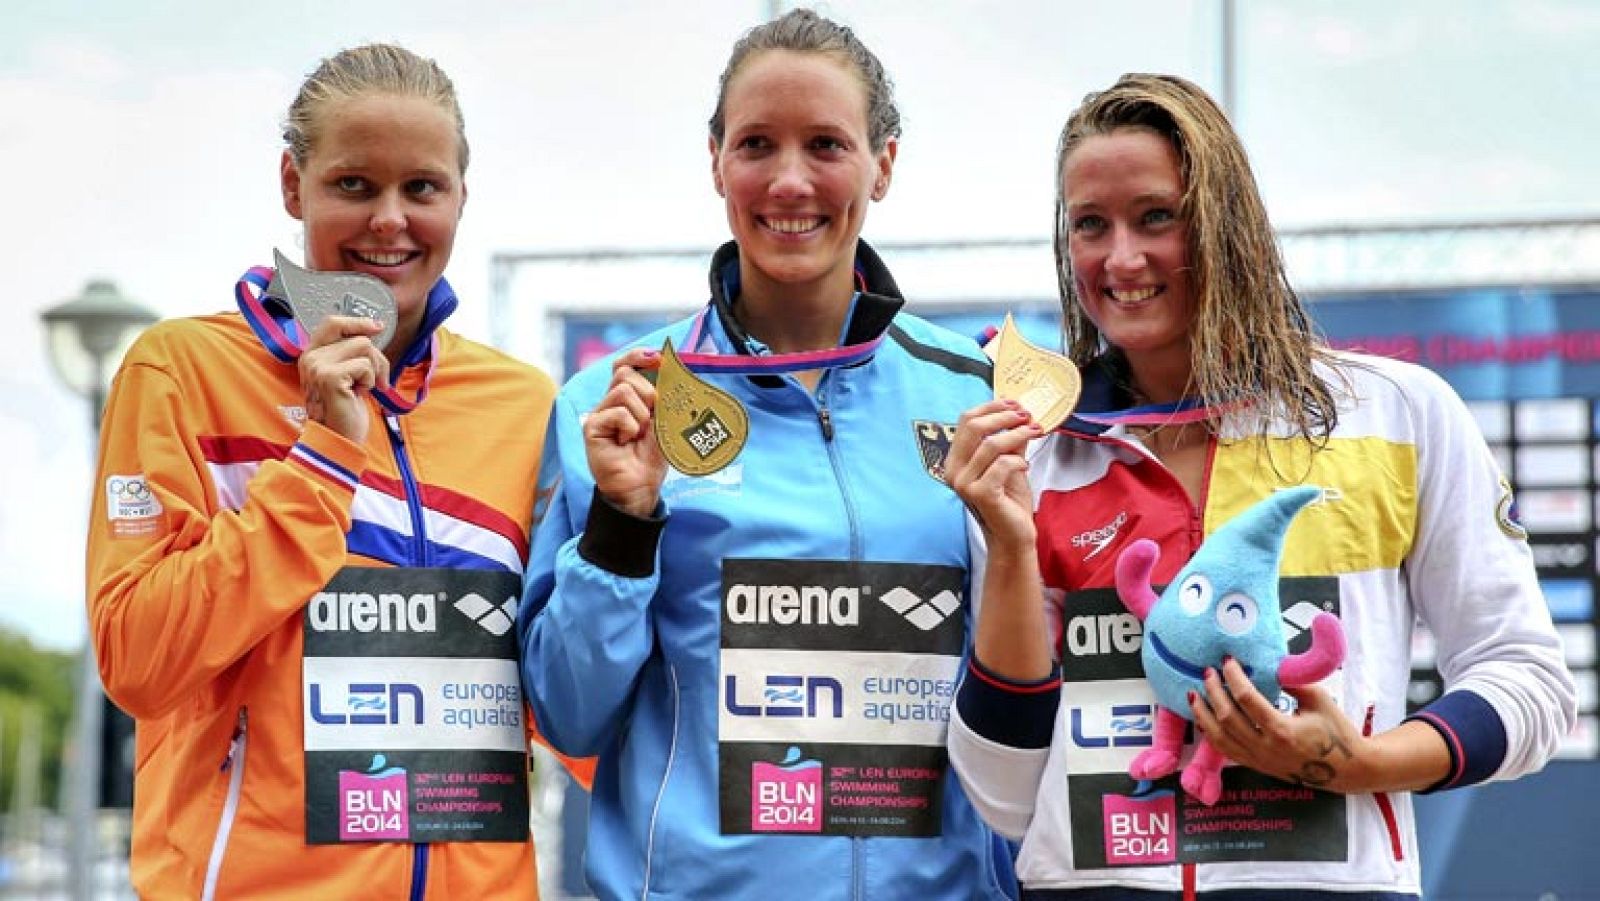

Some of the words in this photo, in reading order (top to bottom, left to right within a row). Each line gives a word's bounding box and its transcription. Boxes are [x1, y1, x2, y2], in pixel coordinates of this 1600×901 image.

[689, 418, 721, 447] BLN
[308, 592, 437, 632] arena
[727, 584, 859, 625] arena
[1067, 613, 1142, 655] are
[310, 684, 424, 724] LEN
[725, 676, 842, 717] LEN
[1071, 705, 1152, 747] LE
[758, 782, 816, 804] BLN
[831, 781, 900, 793] SWIMMING
[346, 789, 403, 813] BLN
[346, 815, 403, 833] 2014
[758, 806, 815, 825] 2014
[1110, 813, 1170, 836] BLN
[1111, 837, 1170, 857] 2014
